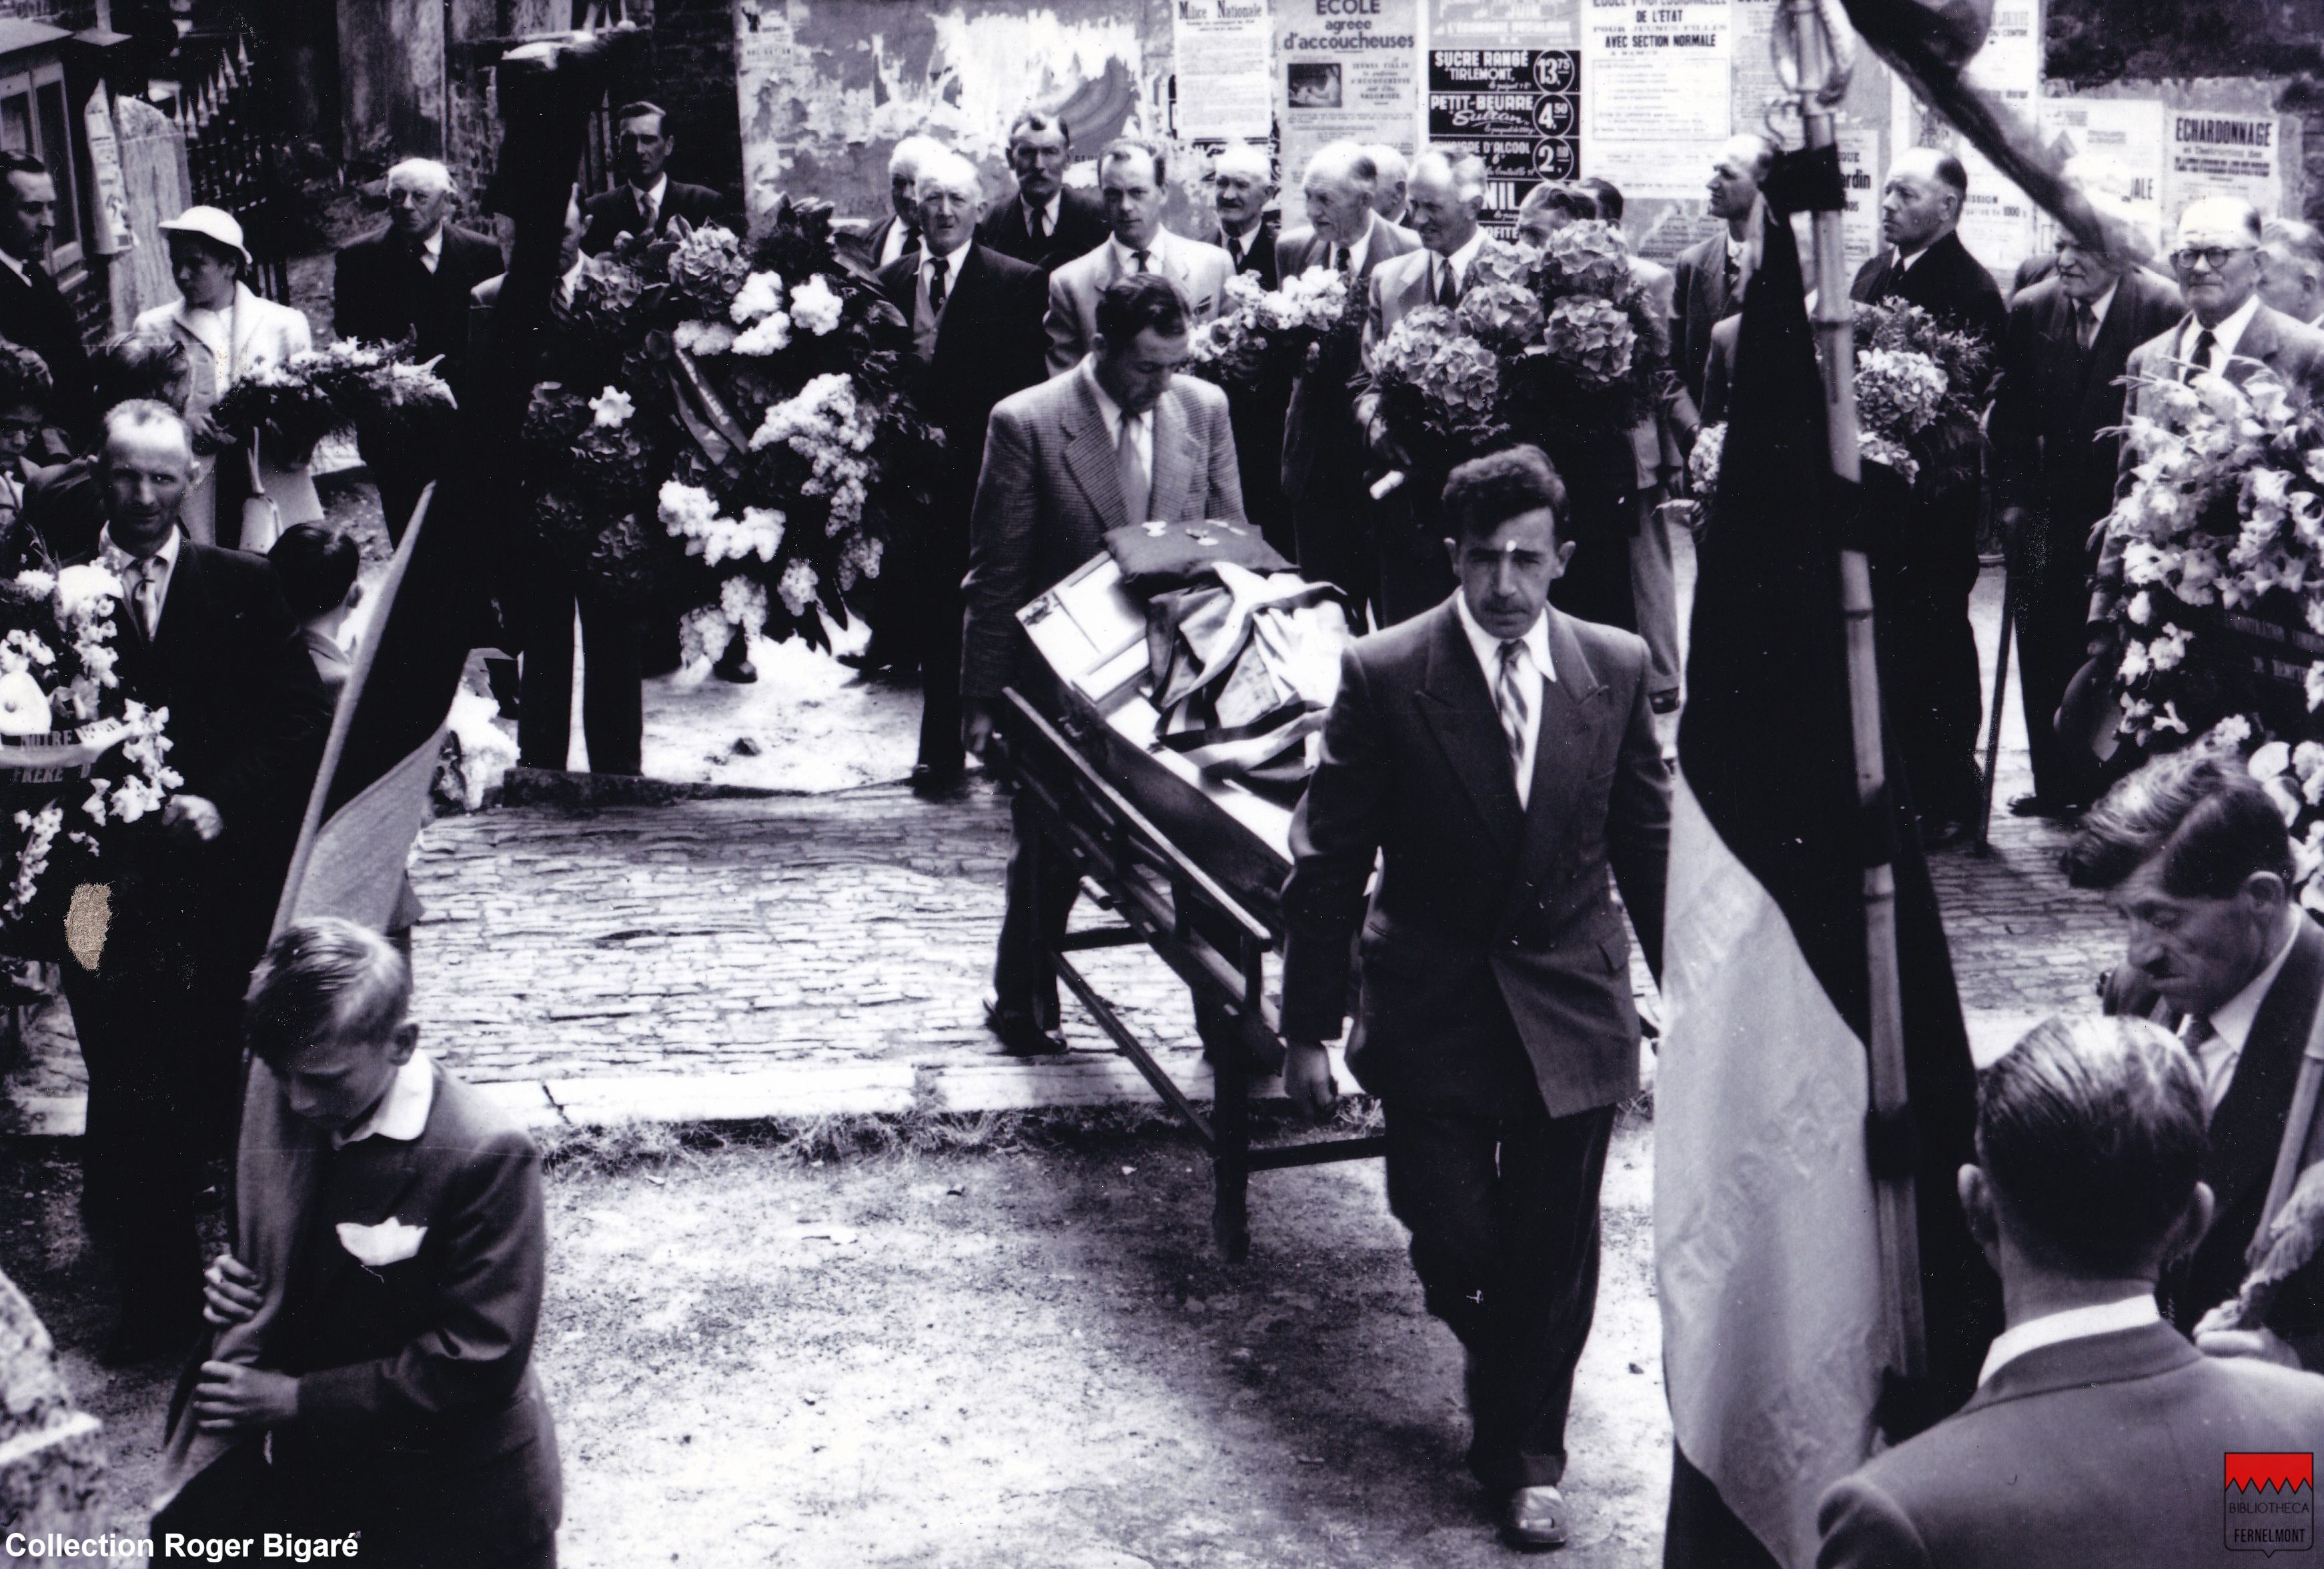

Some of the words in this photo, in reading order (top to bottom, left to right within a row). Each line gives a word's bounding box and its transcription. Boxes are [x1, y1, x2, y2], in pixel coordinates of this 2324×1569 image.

[1217, 1, 1262, 19] Nationale
[1636, 11, 1647, 23] DE
[1283, 31, 1415, 50] d'accoucheuses
[1605, 35, 1628, 47] AVEC
[1632, 35, 1668, 47] SECTION
[1673, 34, 1716, 47] NORMALE
[1435, 51, 1480, 67] SUCRE
[1430, 95, 1534, 111] PETIT-BEURRE
